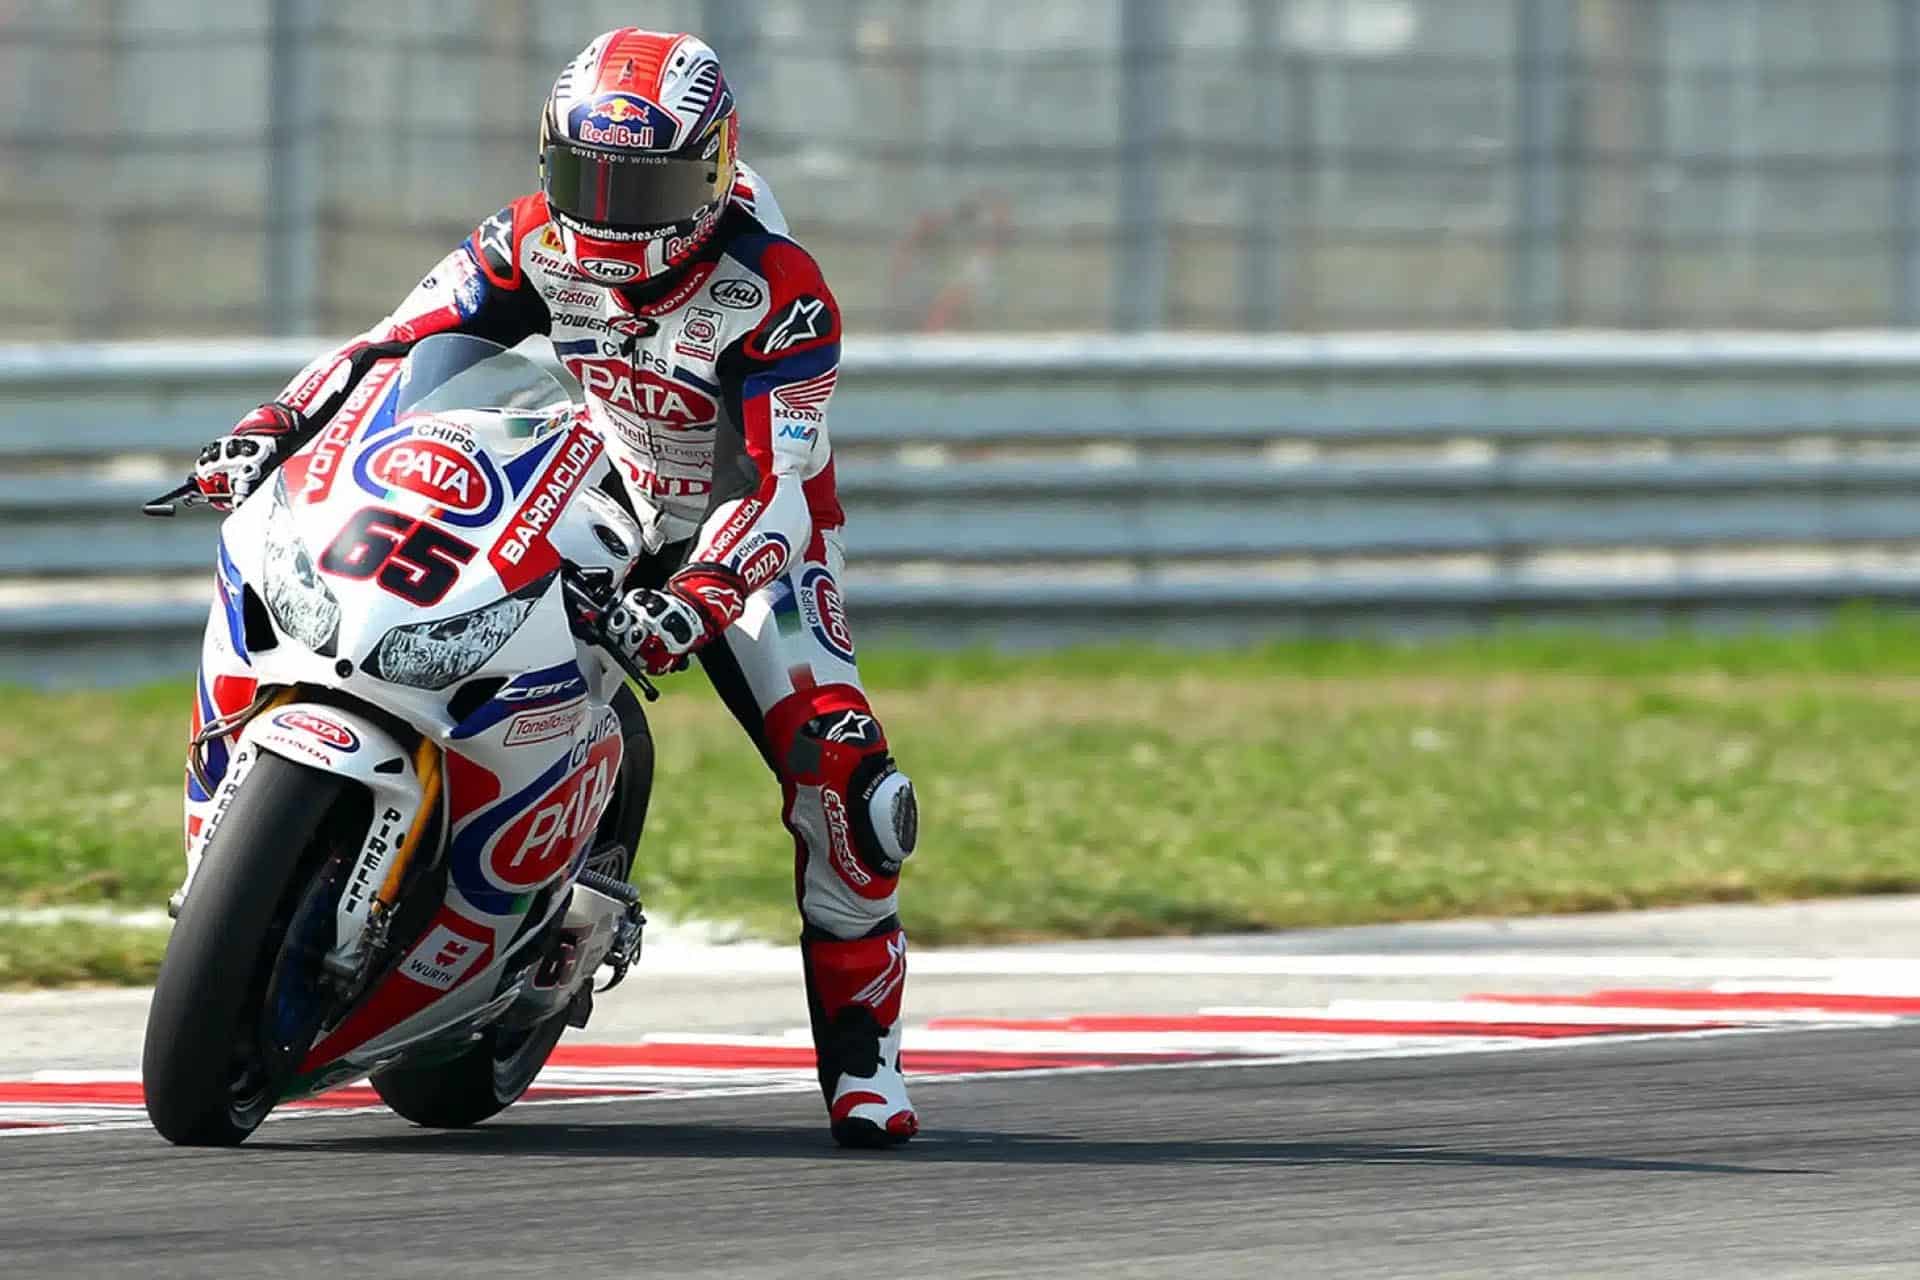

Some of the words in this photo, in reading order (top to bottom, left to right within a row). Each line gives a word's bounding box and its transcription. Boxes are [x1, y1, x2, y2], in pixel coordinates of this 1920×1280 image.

[579, 121, 614, 142] Red
[616, 127, 655, 148] Bull
[571, 147, 597, 160] GIVES
[603, 153, 625, 163] YOU
[631, 156, 669, 165] WINGS
[559, 212, 678, 241] www.jonathan-rea.com
[589, 261, 630, 277] Arai
[556, 289, 600, 307] Castrol
[715, 281, 757, 303] Arai
[602, 341, 668, 374] CIPS
[581, 362, 697, 420] PATA
[417, 424, 477, 453] CHIPS
[382, 448, 471, 503] PATA
[498, 427, 600, 566] BARRACUDA
[318, 506, 479, 608] 65
[737, 534, 766, 558] CHIPS
[744, 550, 780, 585] PATA
[800, 589, 818, 625] CHIPS
[829, 590, 851, 645] PATA
[287, 714, 342, 741] PATA
[509, 755, 615, 868] PATA
[344, 807, 402, 914] PIRELLI
